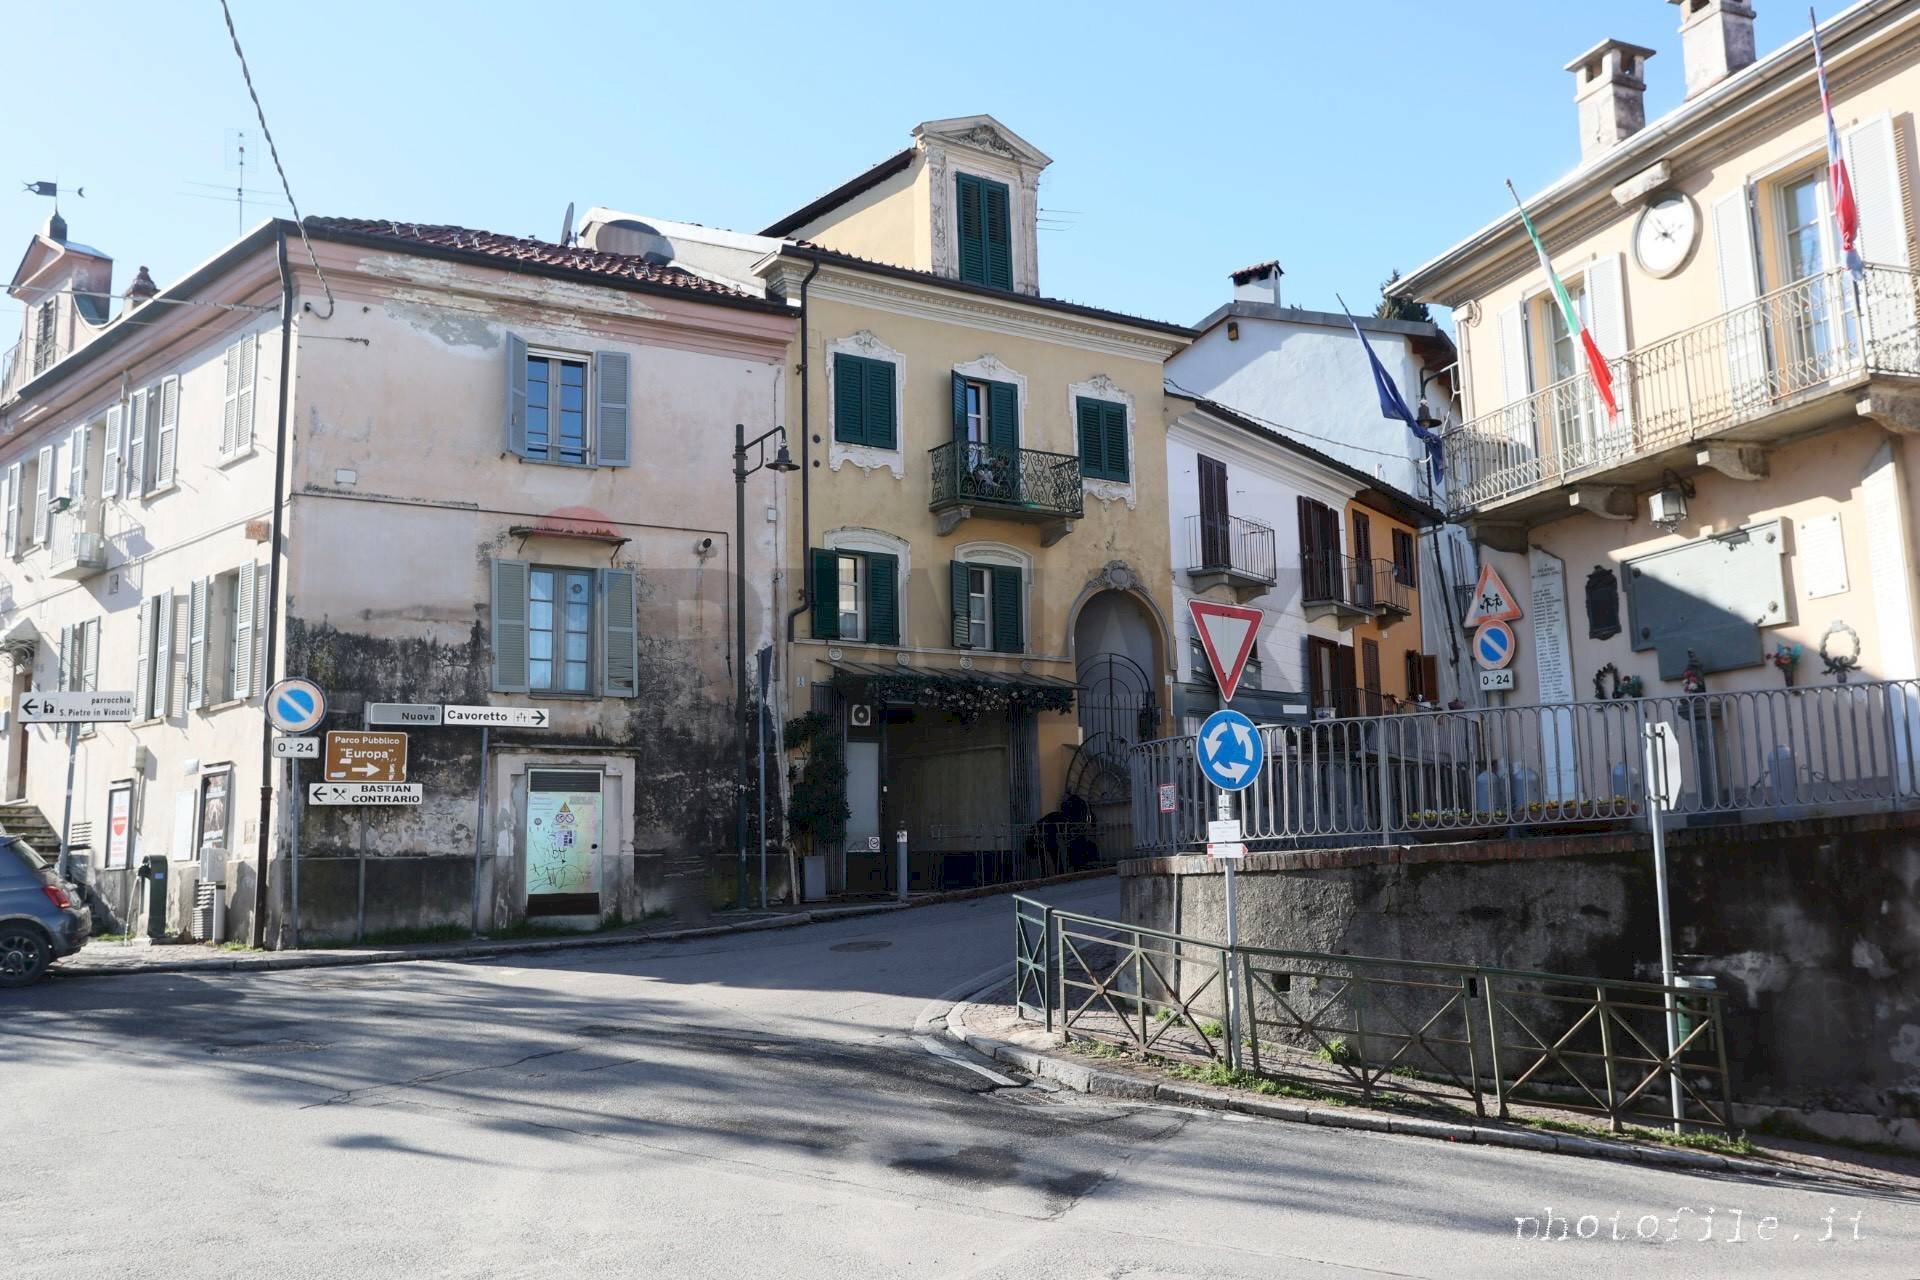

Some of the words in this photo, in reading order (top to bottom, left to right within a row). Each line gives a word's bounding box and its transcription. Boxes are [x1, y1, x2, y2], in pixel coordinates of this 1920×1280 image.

[91, 696, 131, 705] parrocchia
[68, 708, 91, 717] Pietro
[94, 708, 101, 717] in
[103, 708, 130, 716] Vincoli
[401, 712, 436, 721] Nuova
[447, 709, 508, 722] Cavoretto
[334, 736, 361, 745] Parco
[340, 747, 394, 760] "Europa"
[360, 785, 412, 793] BASTIAN
[351, 795, 420, 804] CONTRARIO
